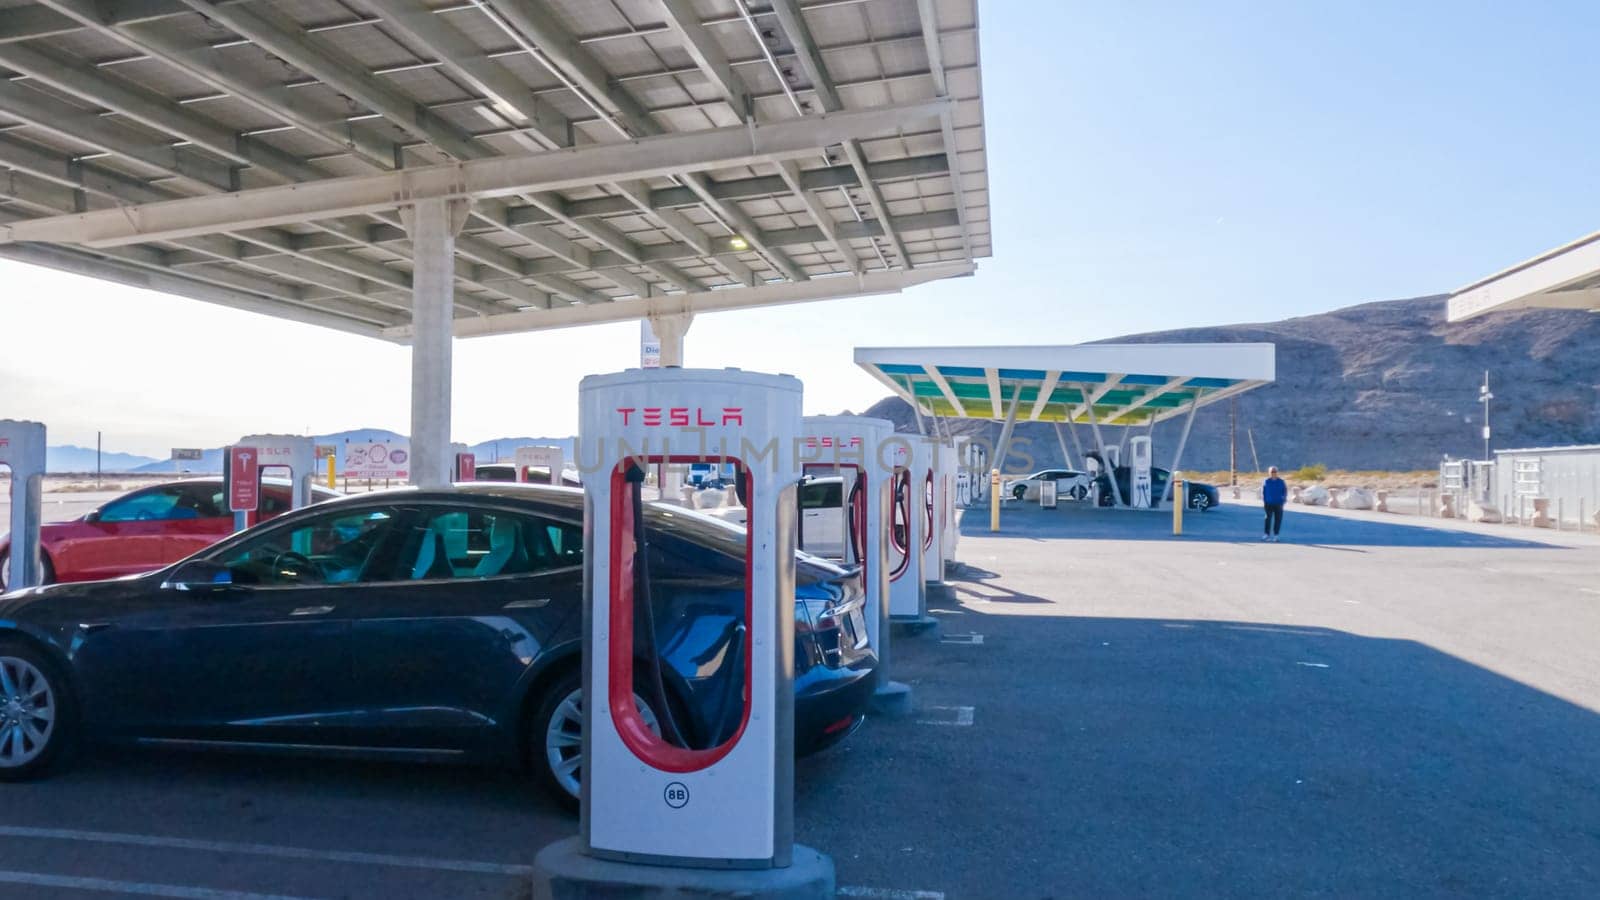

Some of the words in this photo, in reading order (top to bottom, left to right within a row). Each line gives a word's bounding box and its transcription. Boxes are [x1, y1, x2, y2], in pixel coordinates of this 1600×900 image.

[616, 408, 743, 426] TESLA
[807, 437, 862, 448] ESLA
[669, 790, 685, 800] 8B
